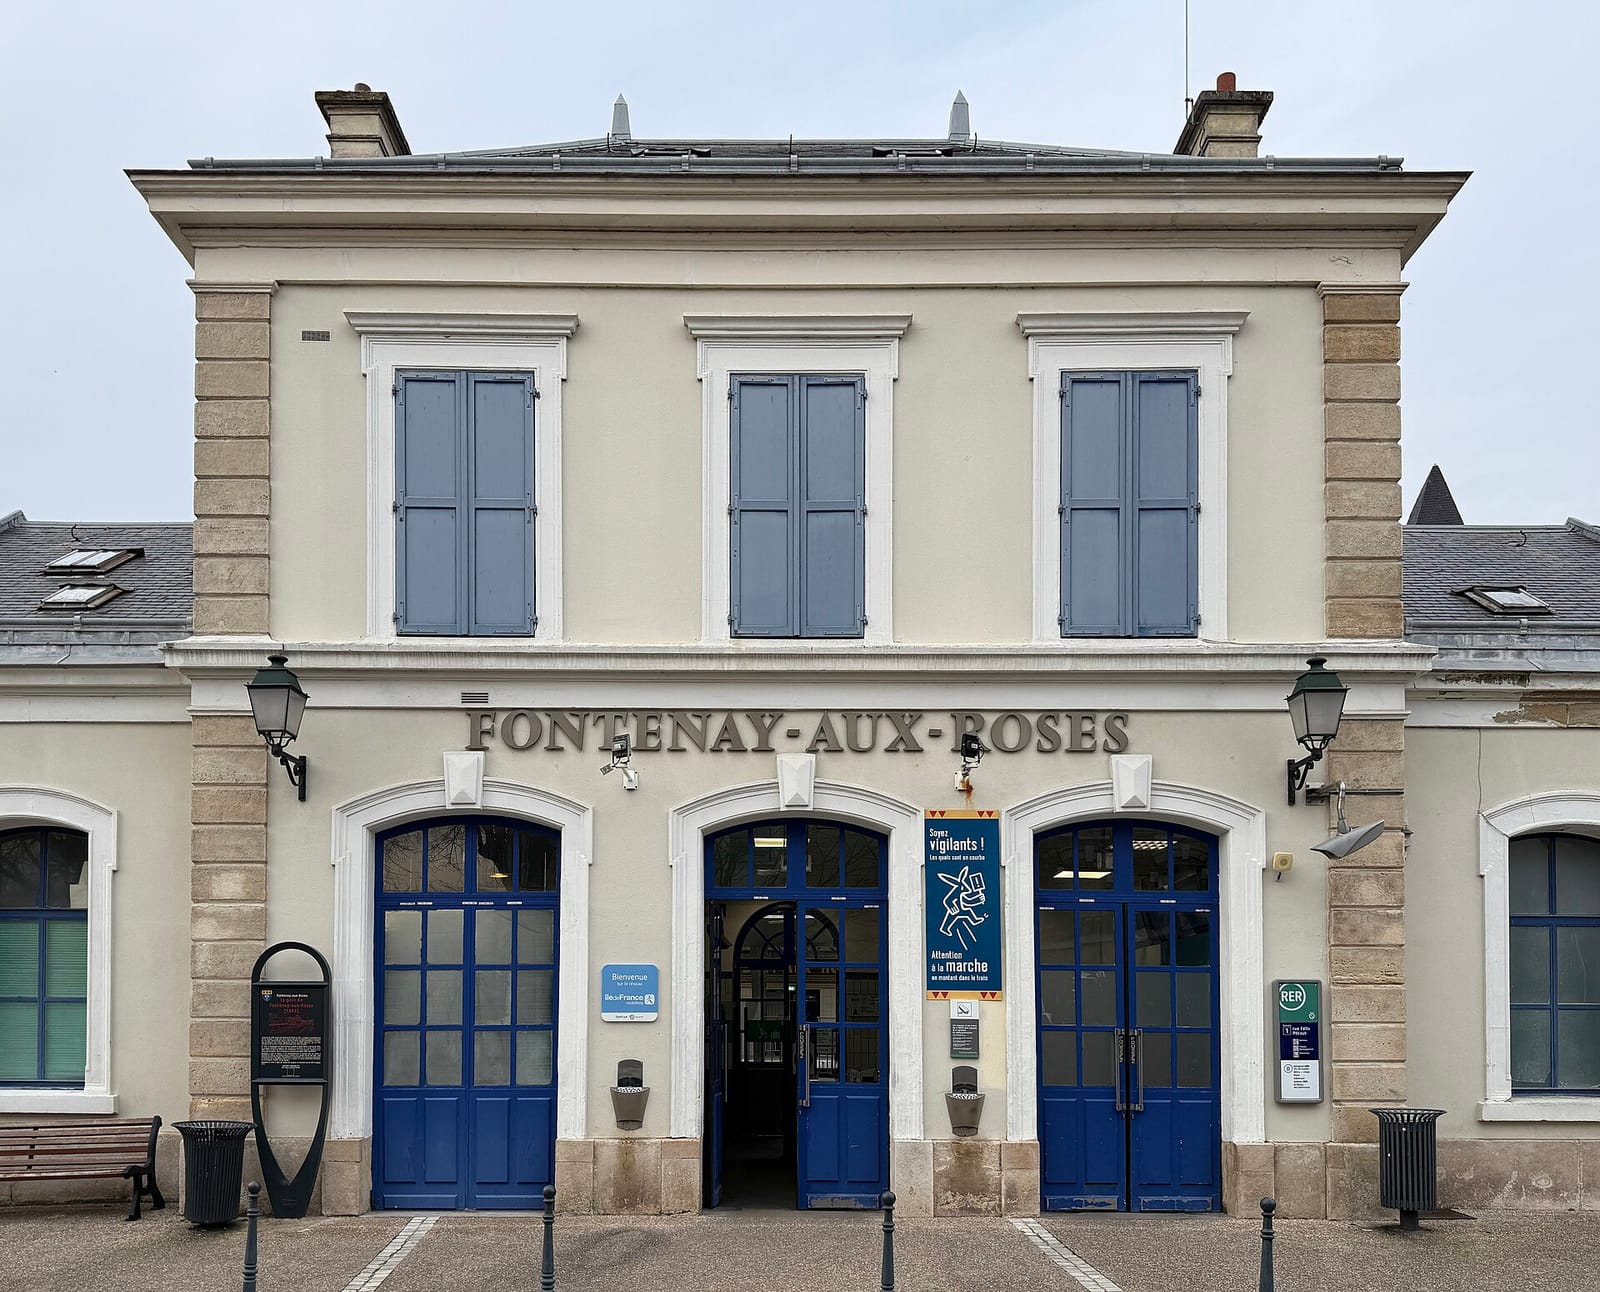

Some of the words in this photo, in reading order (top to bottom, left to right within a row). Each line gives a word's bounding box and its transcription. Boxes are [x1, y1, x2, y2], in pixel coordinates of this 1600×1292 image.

[465, 709, 1129, 752] FONTENAY-AUX-ROSES
[930, 829, 948, 838] Soyez
[930, 837, 978, 854] vigilants
[931, 950, 963, 960] Attention
[937, 963, 944, 972] la
[946, 958, 988, 972] marche
[1281, 991, 1302, 1002] RER
